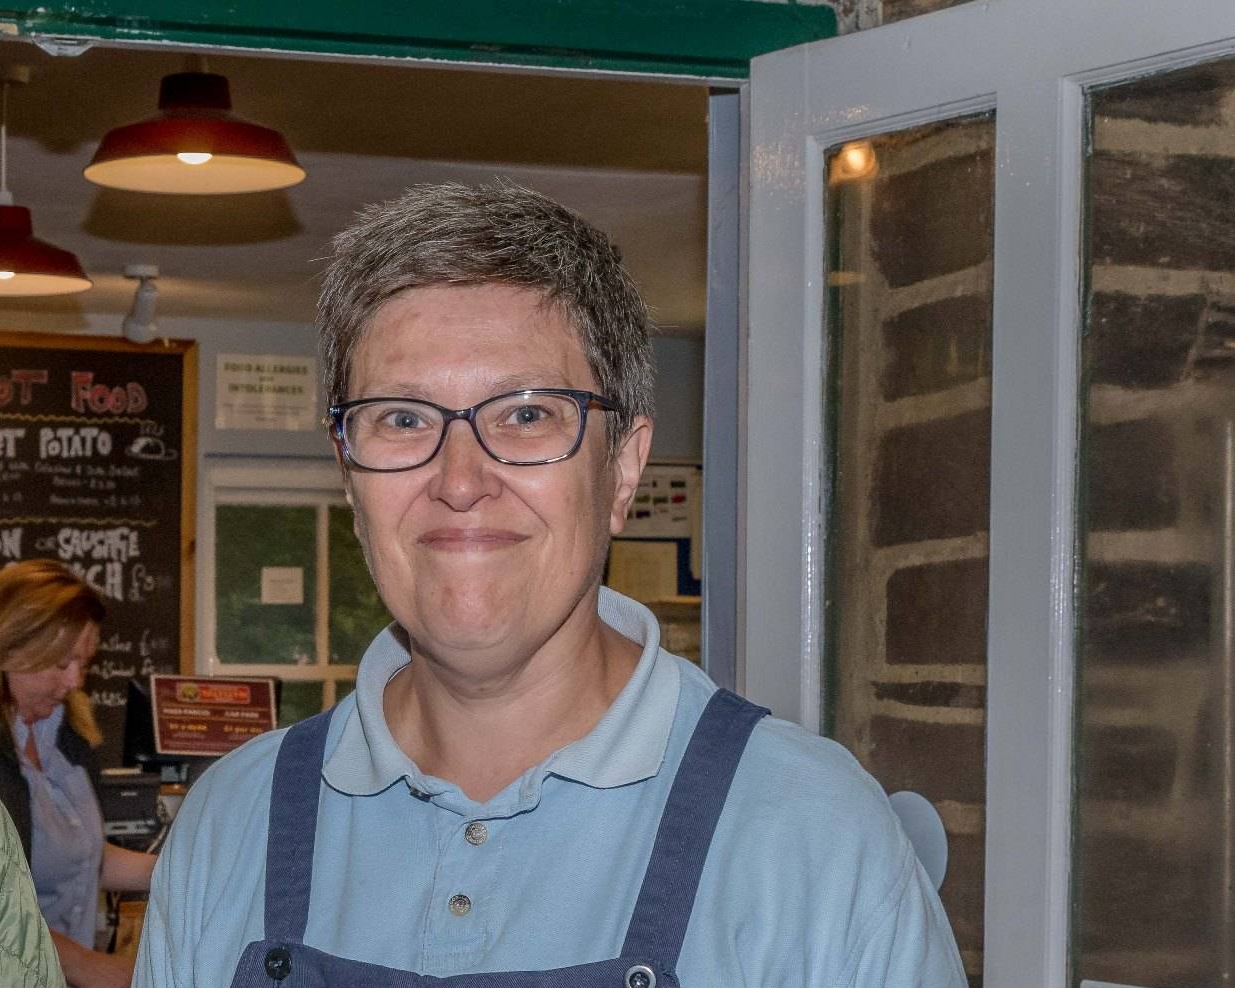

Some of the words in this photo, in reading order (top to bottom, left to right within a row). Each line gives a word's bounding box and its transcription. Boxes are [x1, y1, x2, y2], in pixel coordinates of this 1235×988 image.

[71, 371, 148, 414] FOOD
[39, 427, 113, 458] POTATO
[57, 526, 140, 563] SAUSAGE
